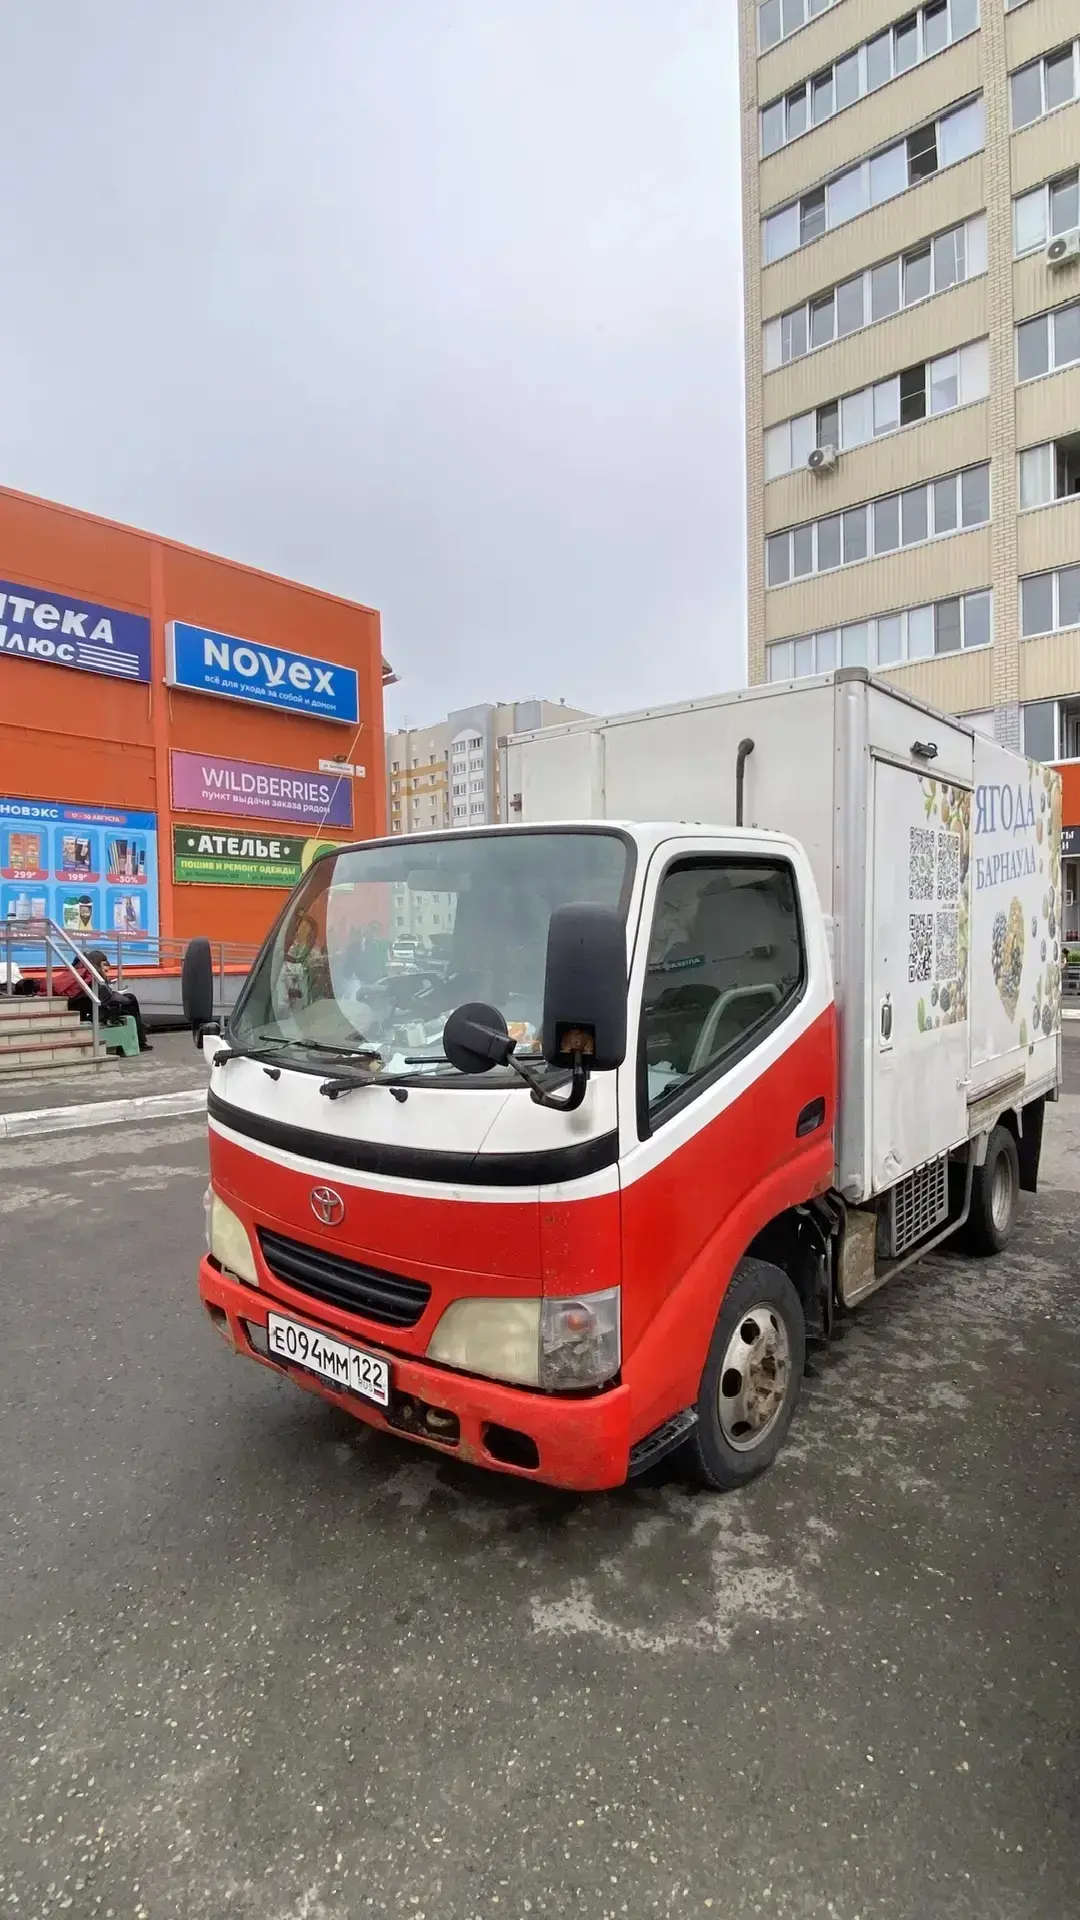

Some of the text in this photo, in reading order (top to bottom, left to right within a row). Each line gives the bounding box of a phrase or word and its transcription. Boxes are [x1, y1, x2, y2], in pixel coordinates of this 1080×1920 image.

[204, 674, 336, 711] всё для ухода за собой и домом
[202, 766, 331, 804] WILDBERRIES
[202, 790, 331, 814] пункт выдачи заказа рядом
[0, 804, 59, 819] НОВЭКС
[974, 783, 1036, 838] ЯГОДА
[197, 834, 281, 859] АТЕЛЬЕ
[181, 859, 296, 876] ПОШИВ И РЕМОНТ ОДЕЖДЫ
[975, 845, 1037, 891] БАРНАУЛА
[352, 1355, 383, 1389] 122
